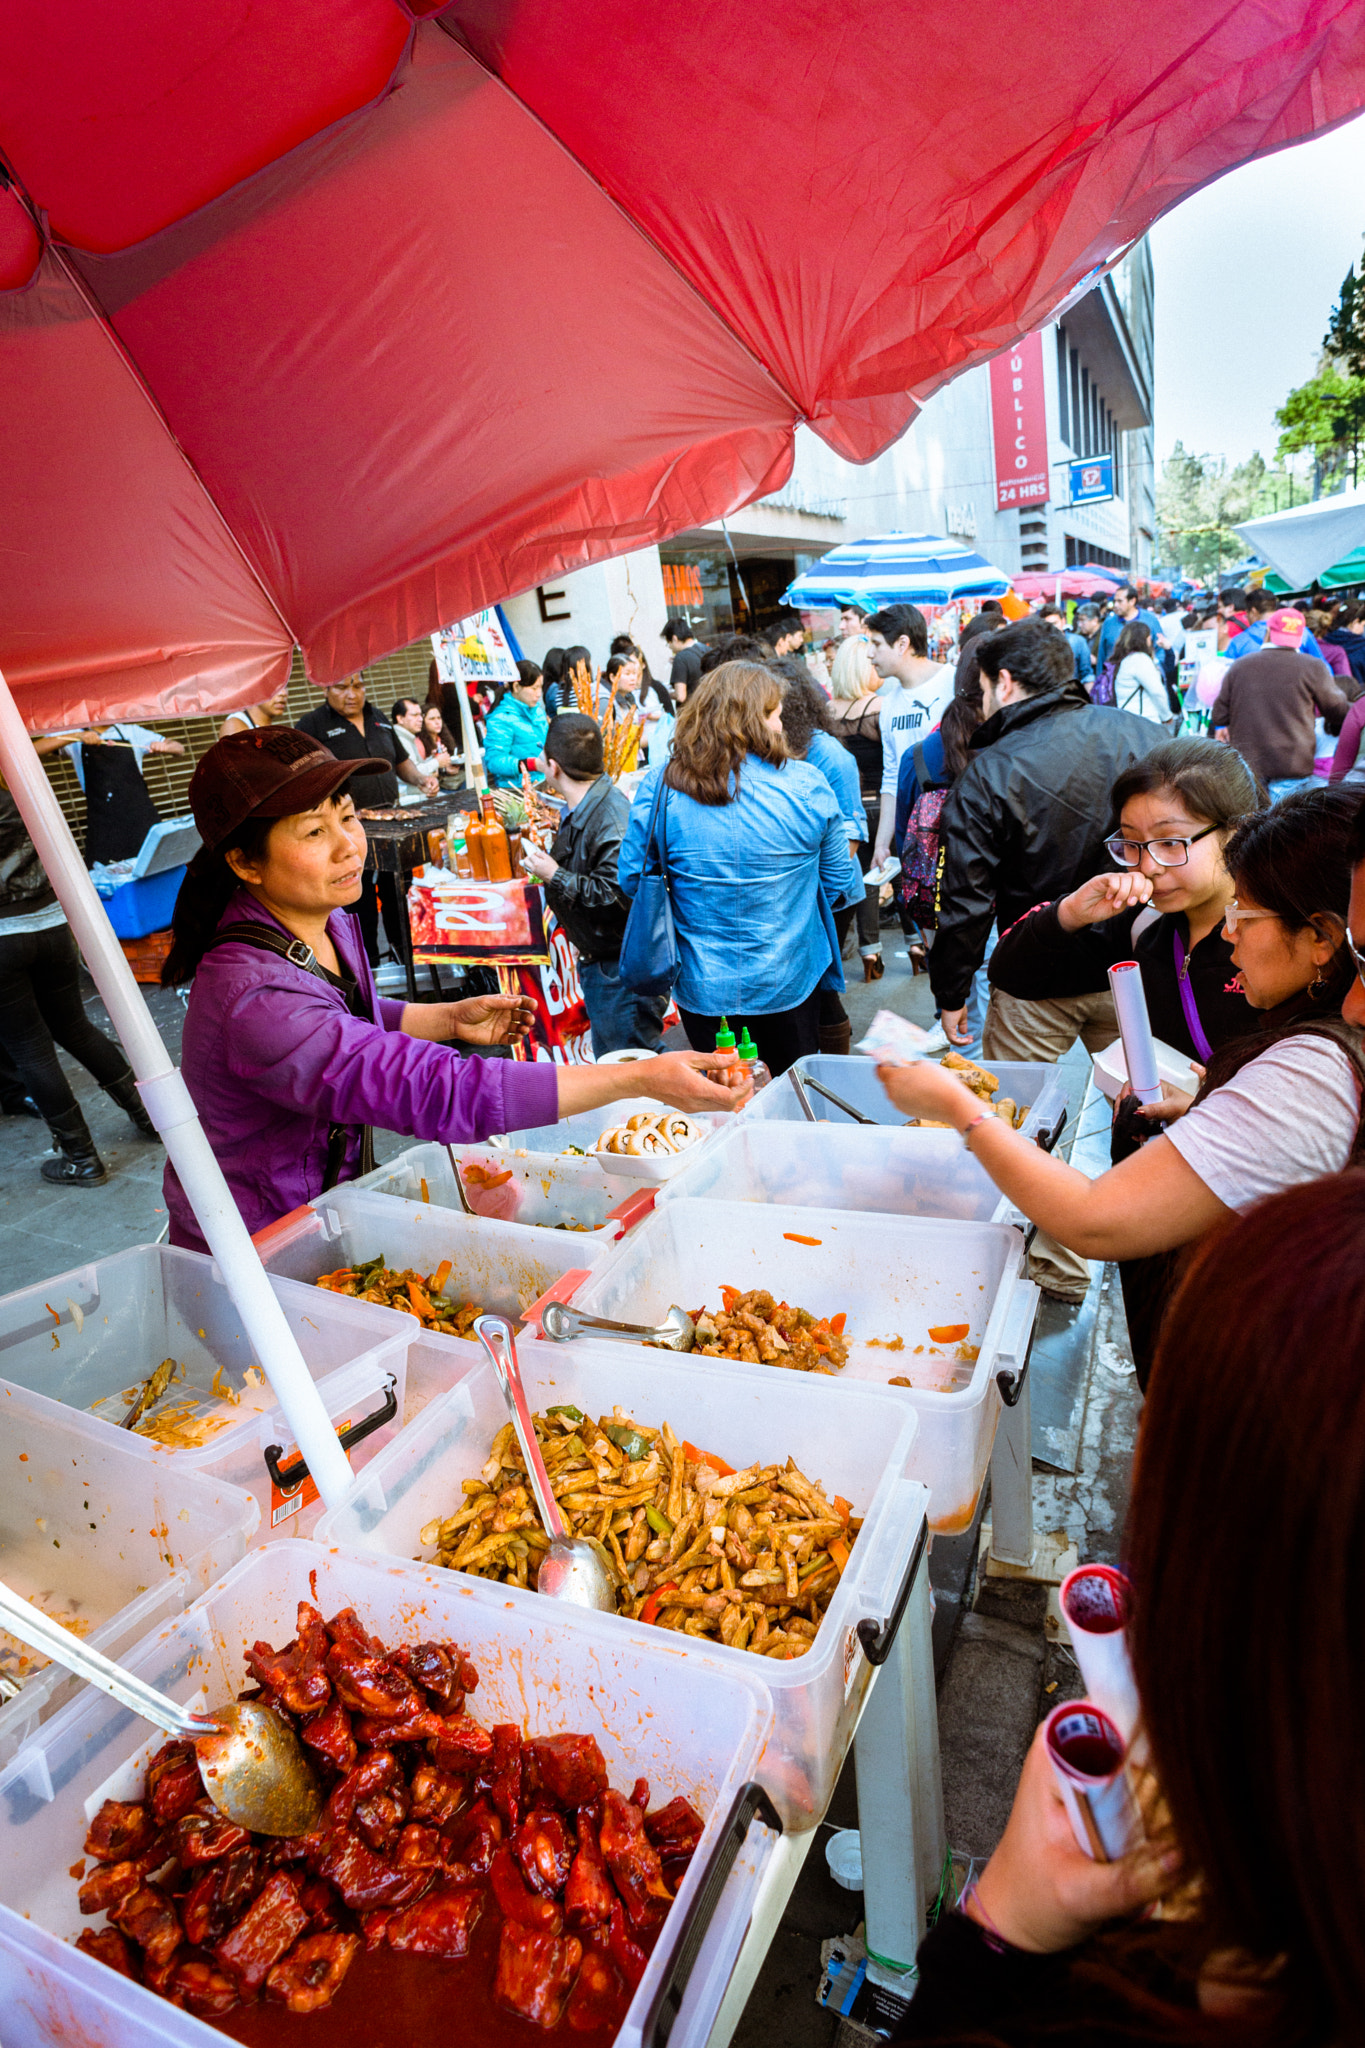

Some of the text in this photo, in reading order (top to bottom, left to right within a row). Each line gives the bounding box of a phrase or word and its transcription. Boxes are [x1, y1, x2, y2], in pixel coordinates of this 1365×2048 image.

[1010, 342, 1028, 469] ÚBLICO
[1000, 482, 1046, 502] 24 HRS
[891, 713, 923, 732] PUMA
